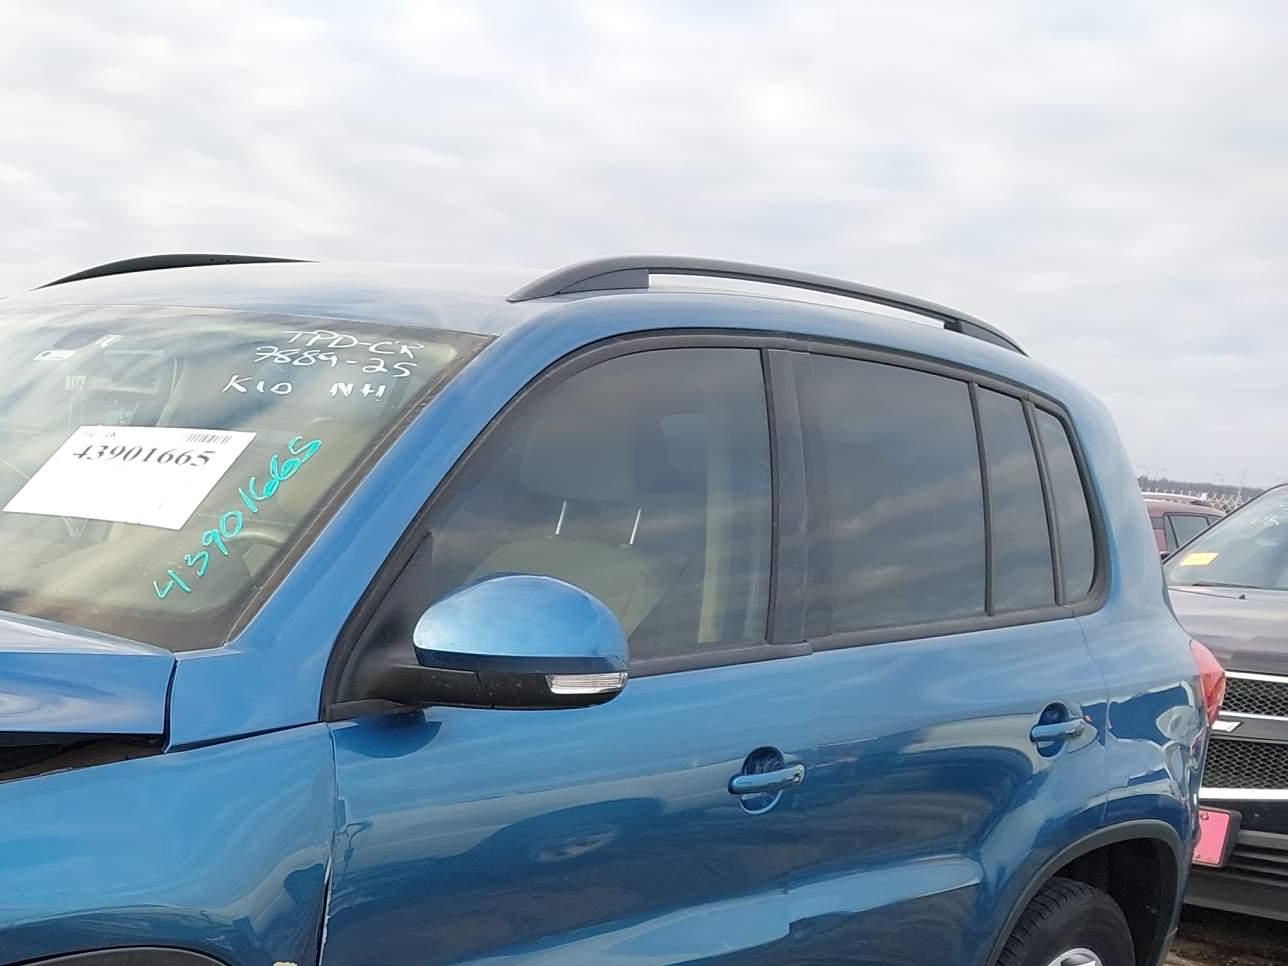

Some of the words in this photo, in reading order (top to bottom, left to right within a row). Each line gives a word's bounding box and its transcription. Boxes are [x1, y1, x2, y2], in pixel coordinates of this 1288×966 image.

[254, 346, 418, 378] 7889-25
[72, 444, 217, 468] 43901665
[153, 435, 323, 599] 43901665
